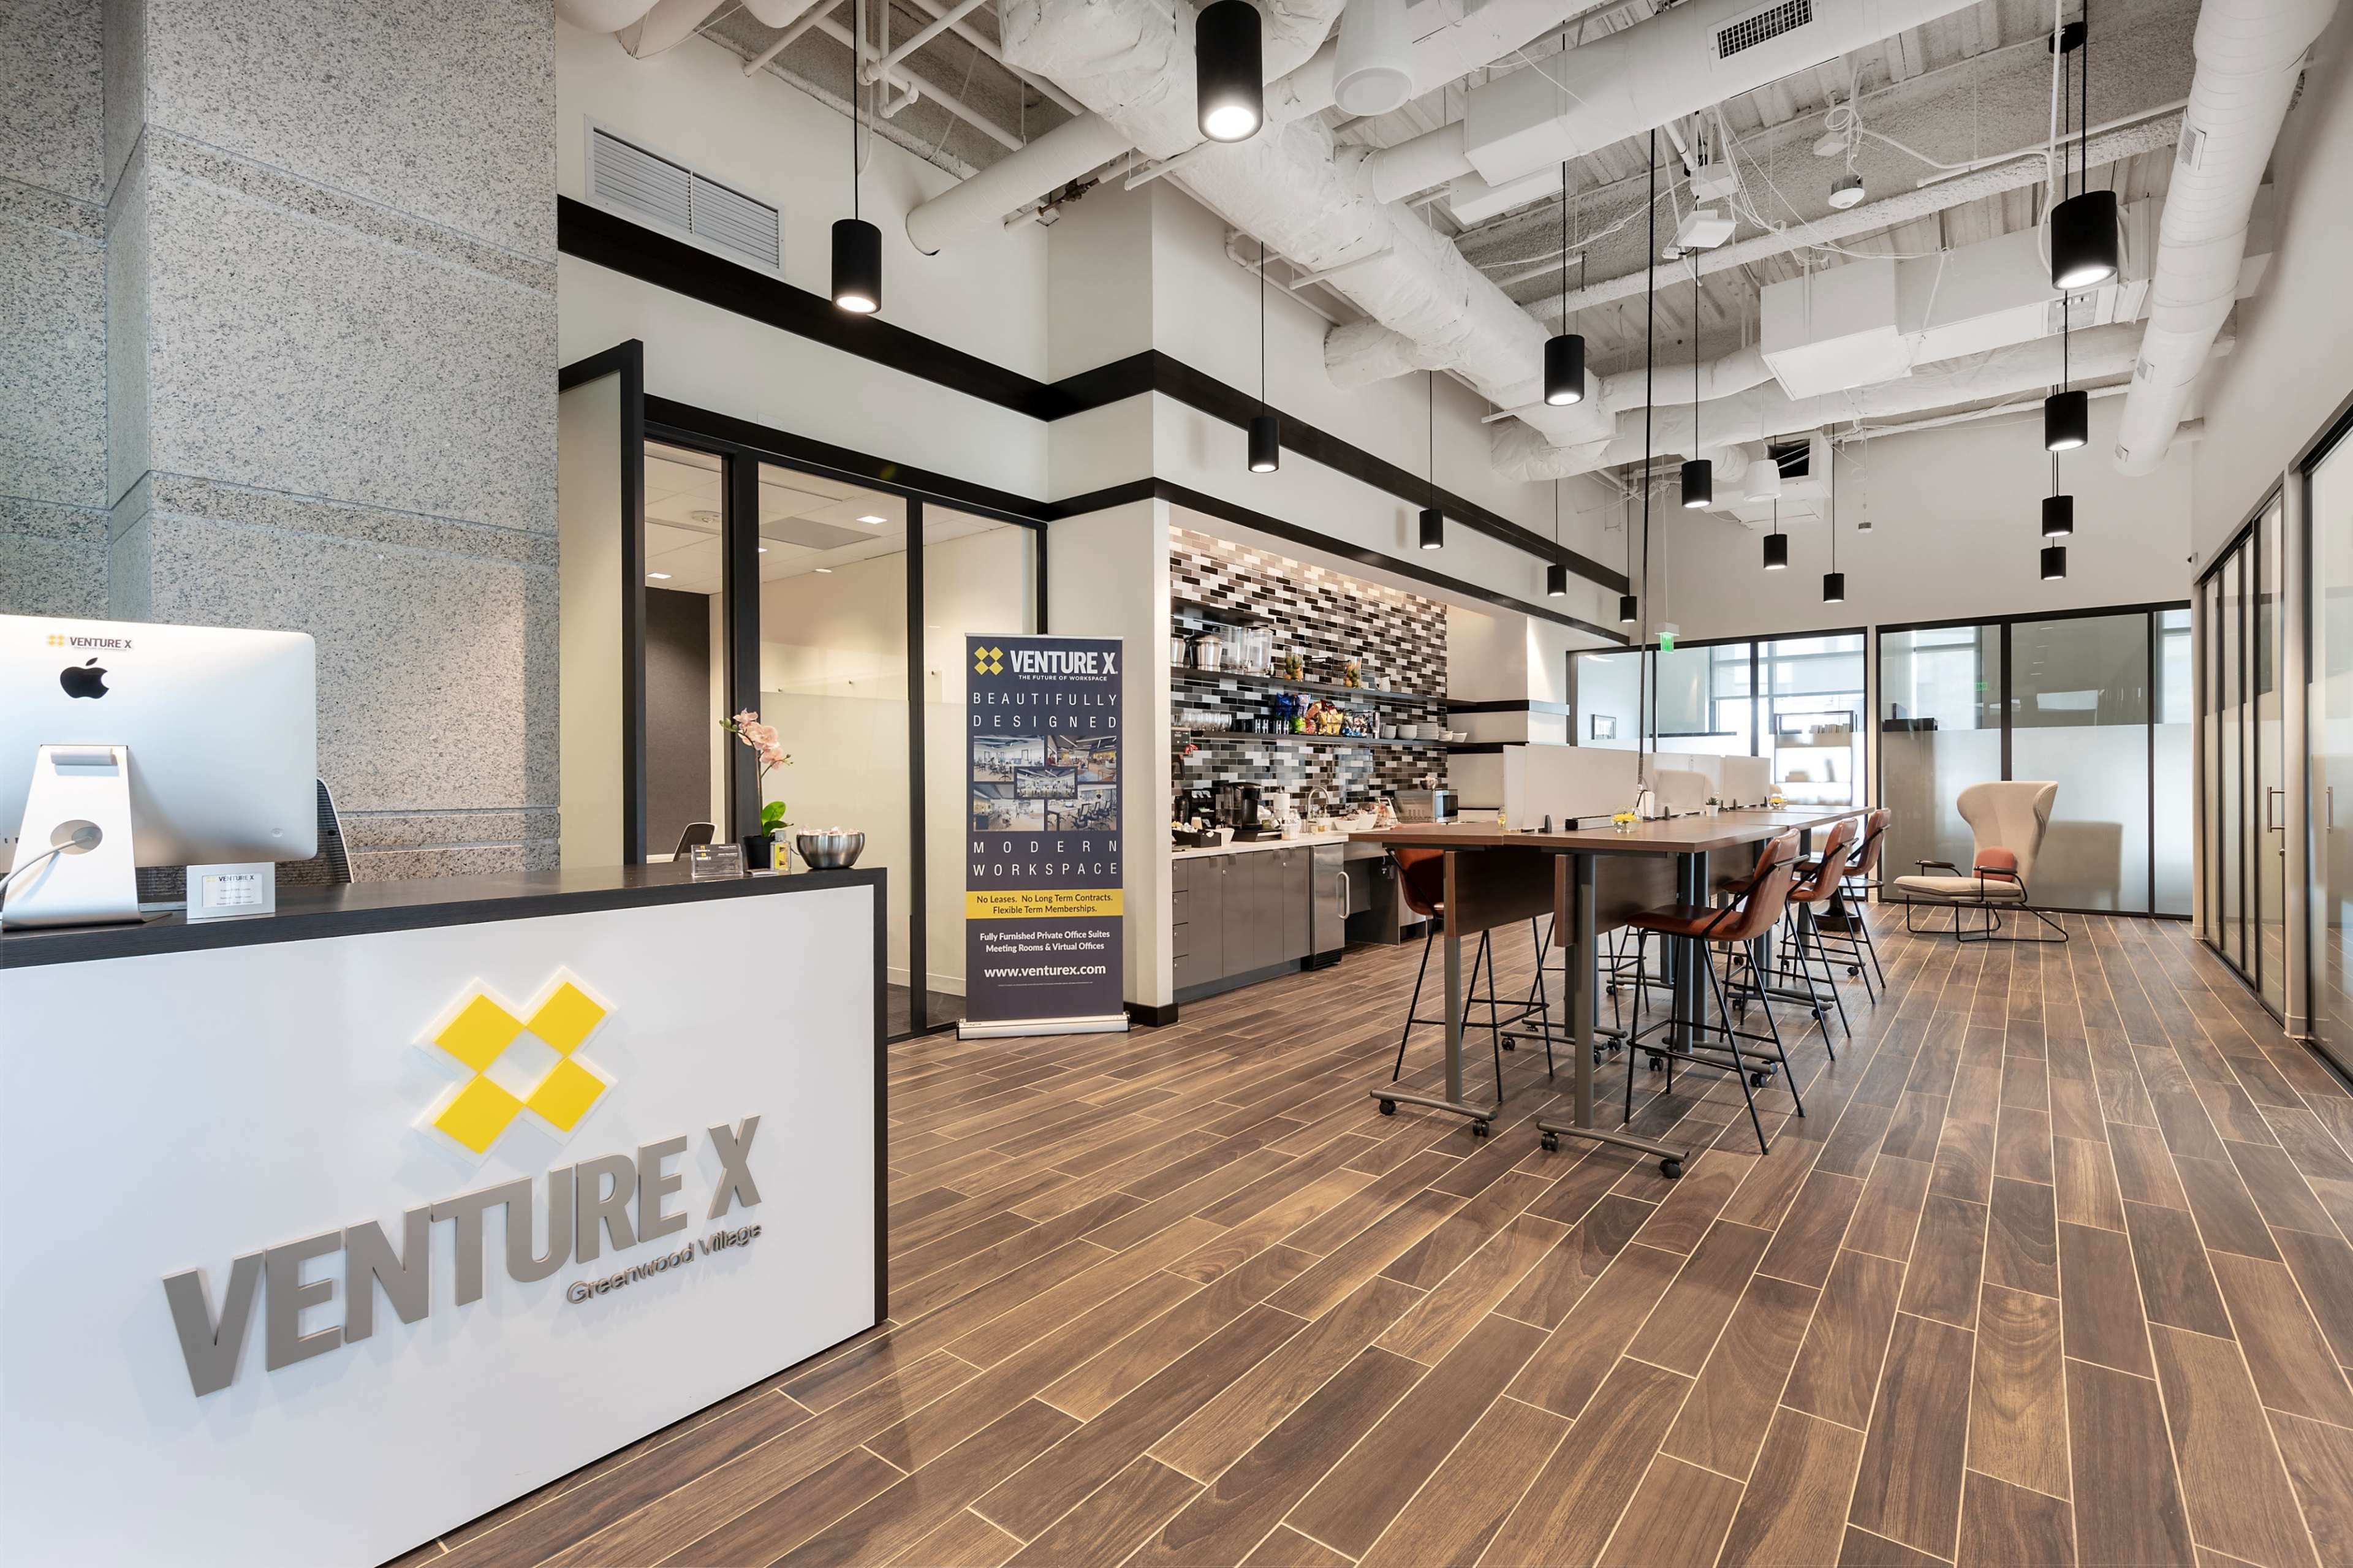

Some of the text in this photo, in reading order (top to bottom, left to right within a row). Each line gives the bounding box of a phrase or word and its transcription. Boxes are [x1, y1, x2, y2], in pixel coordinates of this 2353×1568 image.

[70, 637, 132, 648] VENTURE X
[1010, 650, 1097, 674] VENTURE
[973, 692, 1117, 706] BEAUTIFULLY
[973, 715, 1116, 728] DESIGNED
[973, 841, 1117, 854] MODERN
[973, 863, 1117, 876] WORKSPACE
[1035, 895, 1053, 903] Long
[1045, 904, 1097, 913] Memberships.
[980, 933, 998, 942] Fully
[999, 932, 1036, 941] Furnished
[1064, 930, 1087, 939] Office
[986, 944, 1017, 953] Meeting
[1018, 944, 1043, 952] Rooms
[1052, 942, 1077, 951] Virtual
[1078, 942, 1105, 950] Offices
[984, 965, 1107, 977] www.venturex.com
[162, 1114, 762, 1398] VENTURE X
[567, 1224, 762, 1305] Greenwood Village
